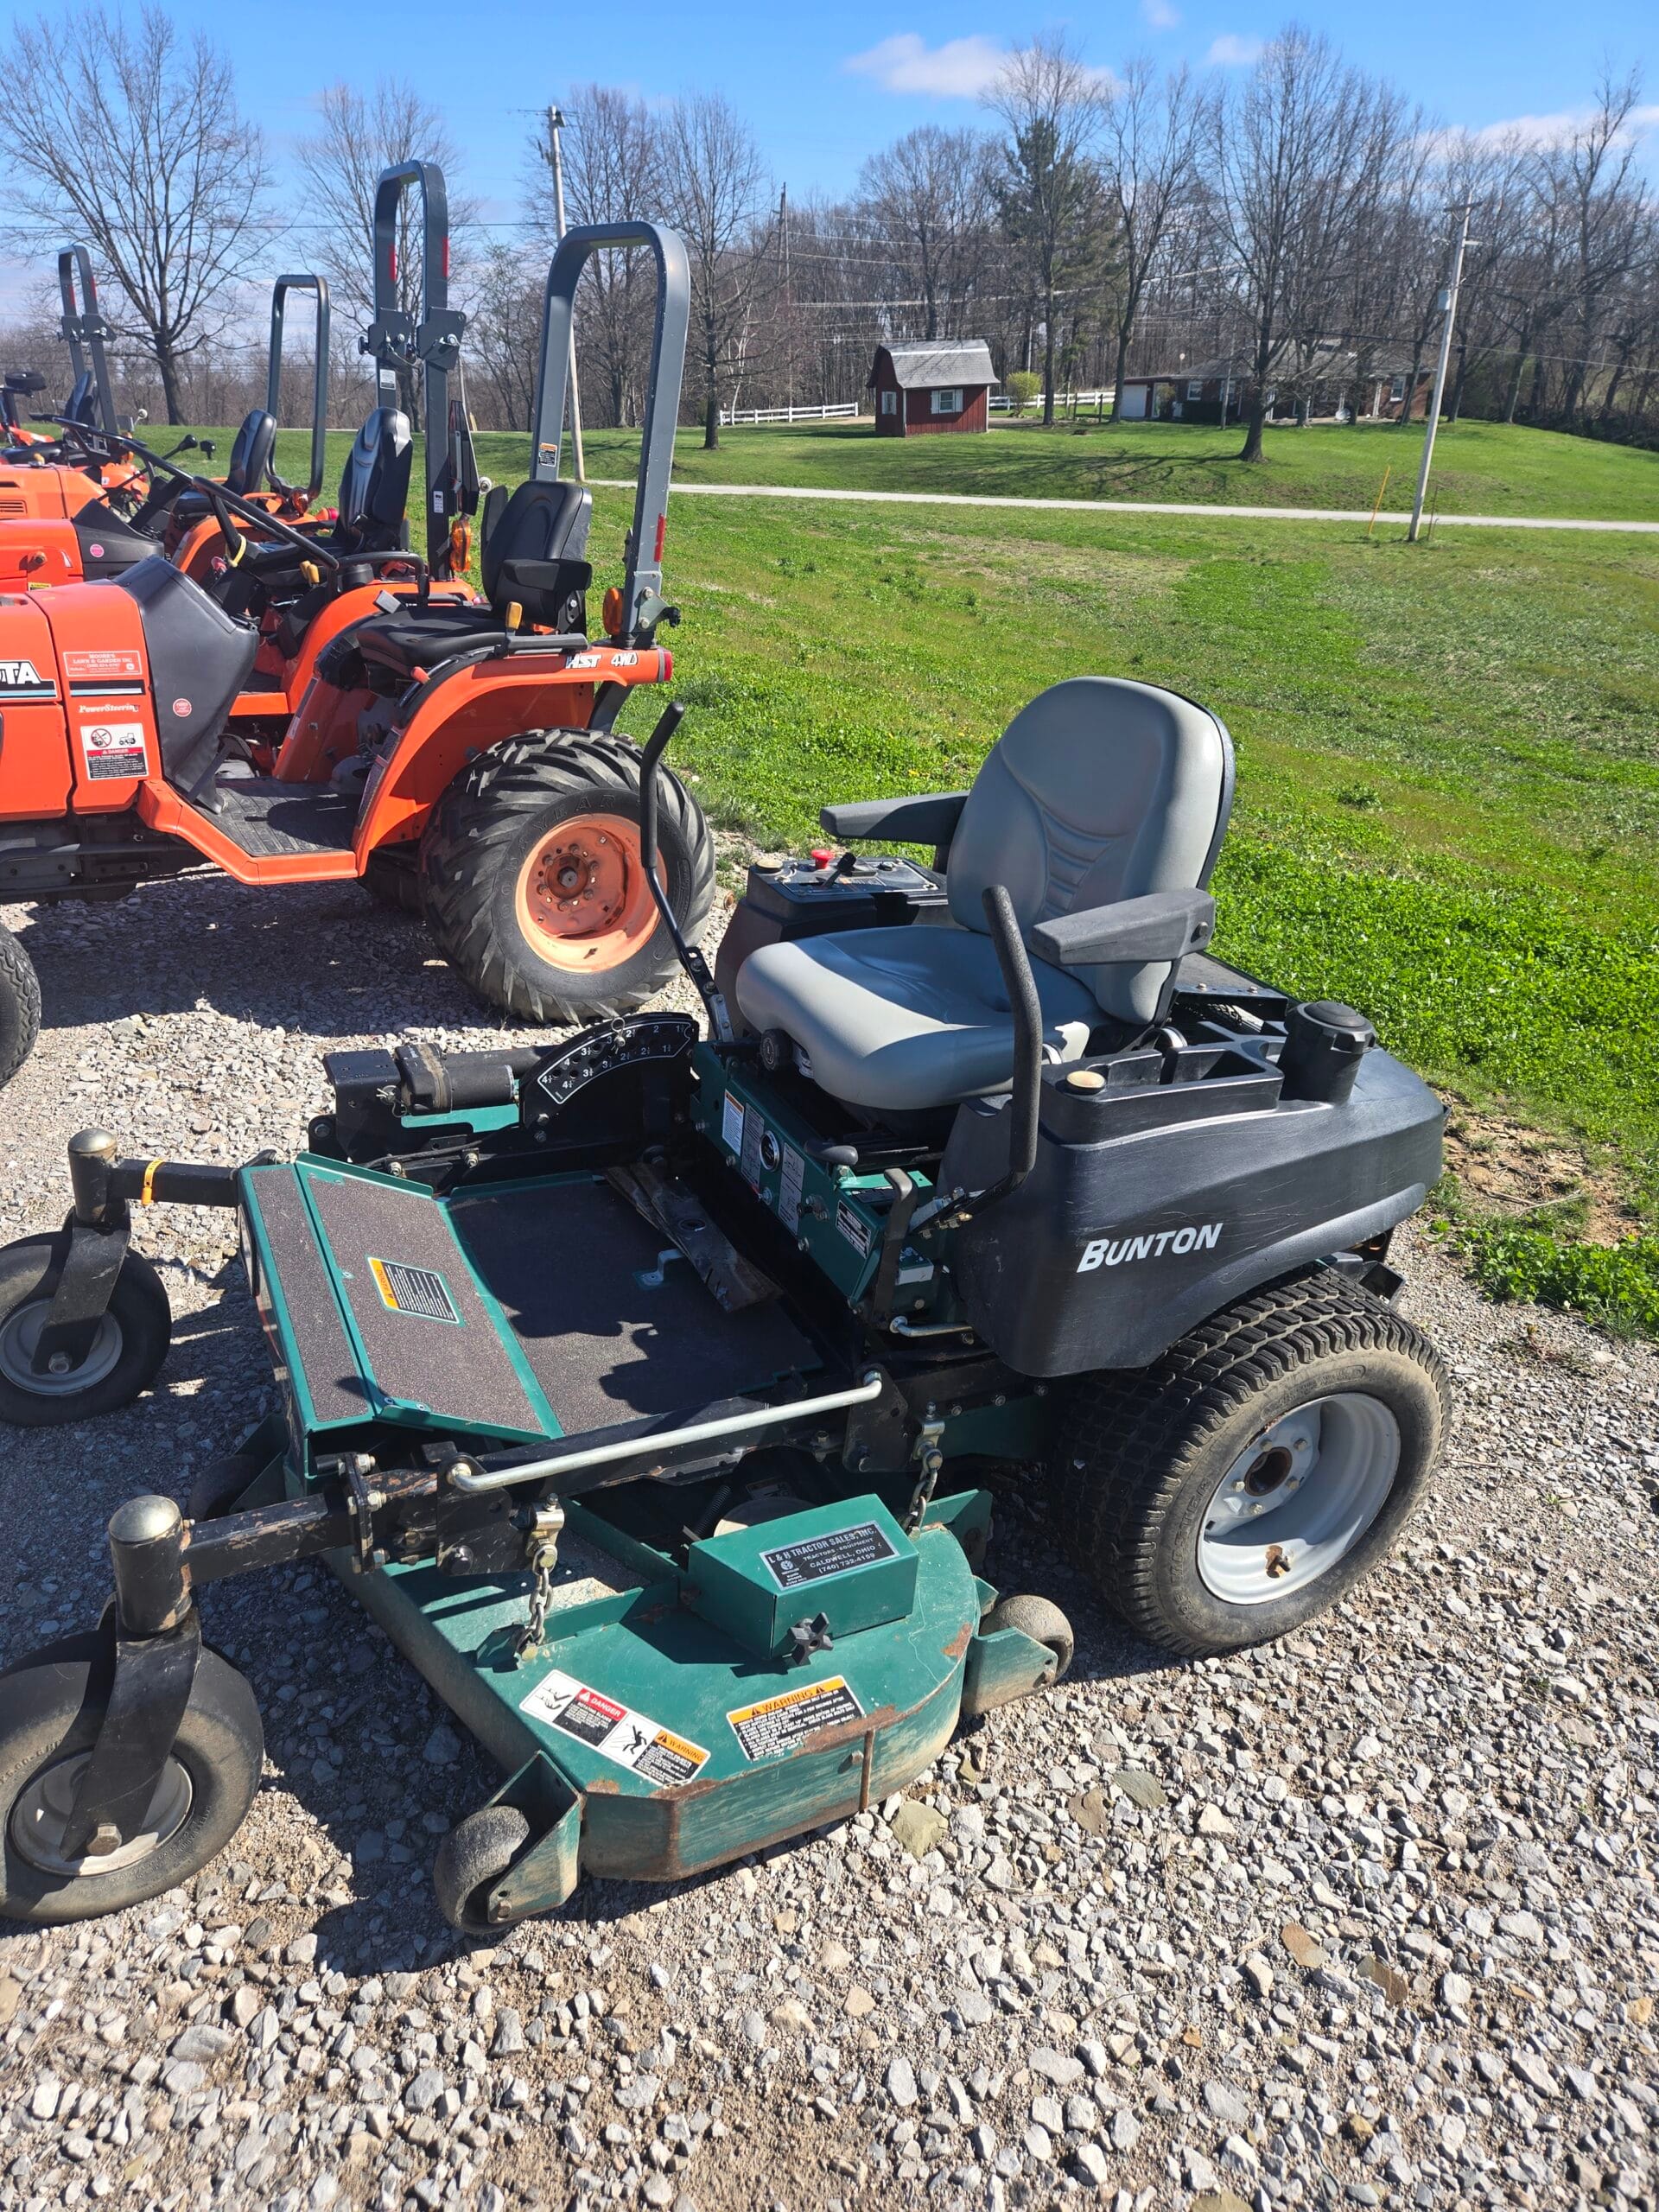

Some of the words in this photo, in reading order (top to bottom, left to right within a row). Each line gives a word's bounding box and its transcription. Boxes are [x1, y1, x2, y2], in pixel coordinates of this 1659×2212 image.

[565, 654, 602, 669] HST
[611, 652, 638, 667] 4WD
[0, 662, 41, 684] TA
[563, 1058, 570, 1066] 4
[652, 1025, 659, 1033] 2
[1076, 1223, 1224, 1274] BUNTON
[791, 1541, 830, 1557] TRACTOR
[830, 1533, 859, 1546] SALES,
[803, 1548, 836, 1561] TRACTORS
[839, 1538, 874, 1551] EQUIPMENT
[810, 1552, 855, 1568] CALDWELL,
[855, 1545, 876, 1554] OHIO
[818, 1563, 840, 1574] (740)
[590, 1697, 621, 1718] DANGER
[761, 1689, 813, 1713] WARNING
[669, 1739, 704, 1761] WARNING
